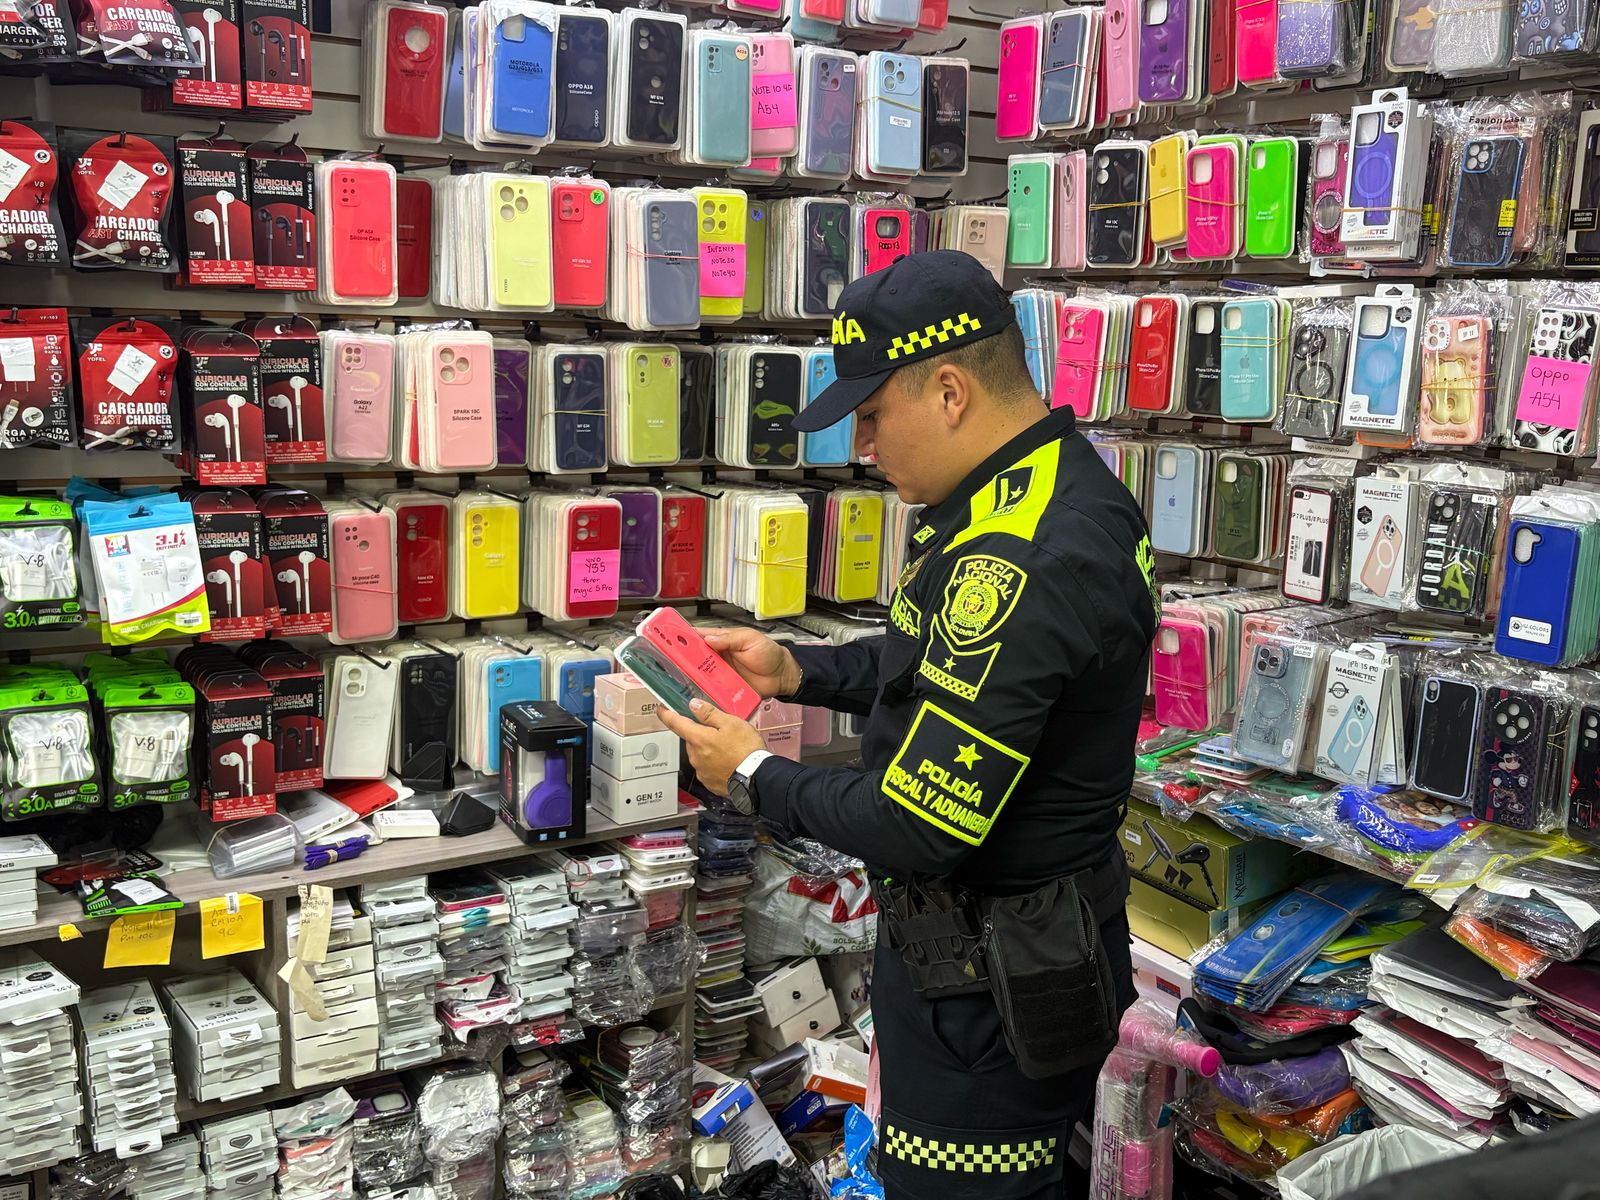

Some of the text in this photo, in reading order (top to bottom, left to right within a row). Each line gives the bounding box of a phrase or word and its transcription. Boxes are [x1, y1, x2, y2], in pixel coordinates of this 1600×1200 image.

[107, 7, 176, 25] CARGADOR
[105, 20, 182, 36] FAST CHARGER
[510, 59, 540, 68] MOTOROLA
[772, 85, 781, 93] 10
[757, 101, 780, 114] A54
[183, 169, 236, 179] AURICULAR
[253, 178, 303, 187] AURICULAR
[260, 357, 309, 366] AURICULAR
[195, 375, 247, 383] AURICULAR
[98, 401, 168, 415] CARGADOR
[94, 414, 172, 425] FAST CHARGER
[1349, 415, 1396, 425] MAGNETIC
[1305, 443, 1315, 451] High
[1362, 488, 1402, 499] MAGNETIC
[198, 531, 249, 540] AURICULAR
[269, 532, 318, 541] AURICULAR
[1420, 522, 1449, 597] JORDAN
[965, 559, 1015, 584] POLICÍA
[953, 570, 1013, 601] NACIONAL
[950, 623, 980, 637] COLOMBIA
[1334, 666, 1377, 682] MAGNETIC
[272, 693, 314, 701] URICULAR
[641, 703, 657, 712] GEN
[211, 714, 262, 726] AURICULAR
[887, 765, 924, 801] FISCAL
[922, 786, 937, 806] Y
[917, 758, 983, 808] POLICÍA
[636, 791, 663, 802] GEN 12
